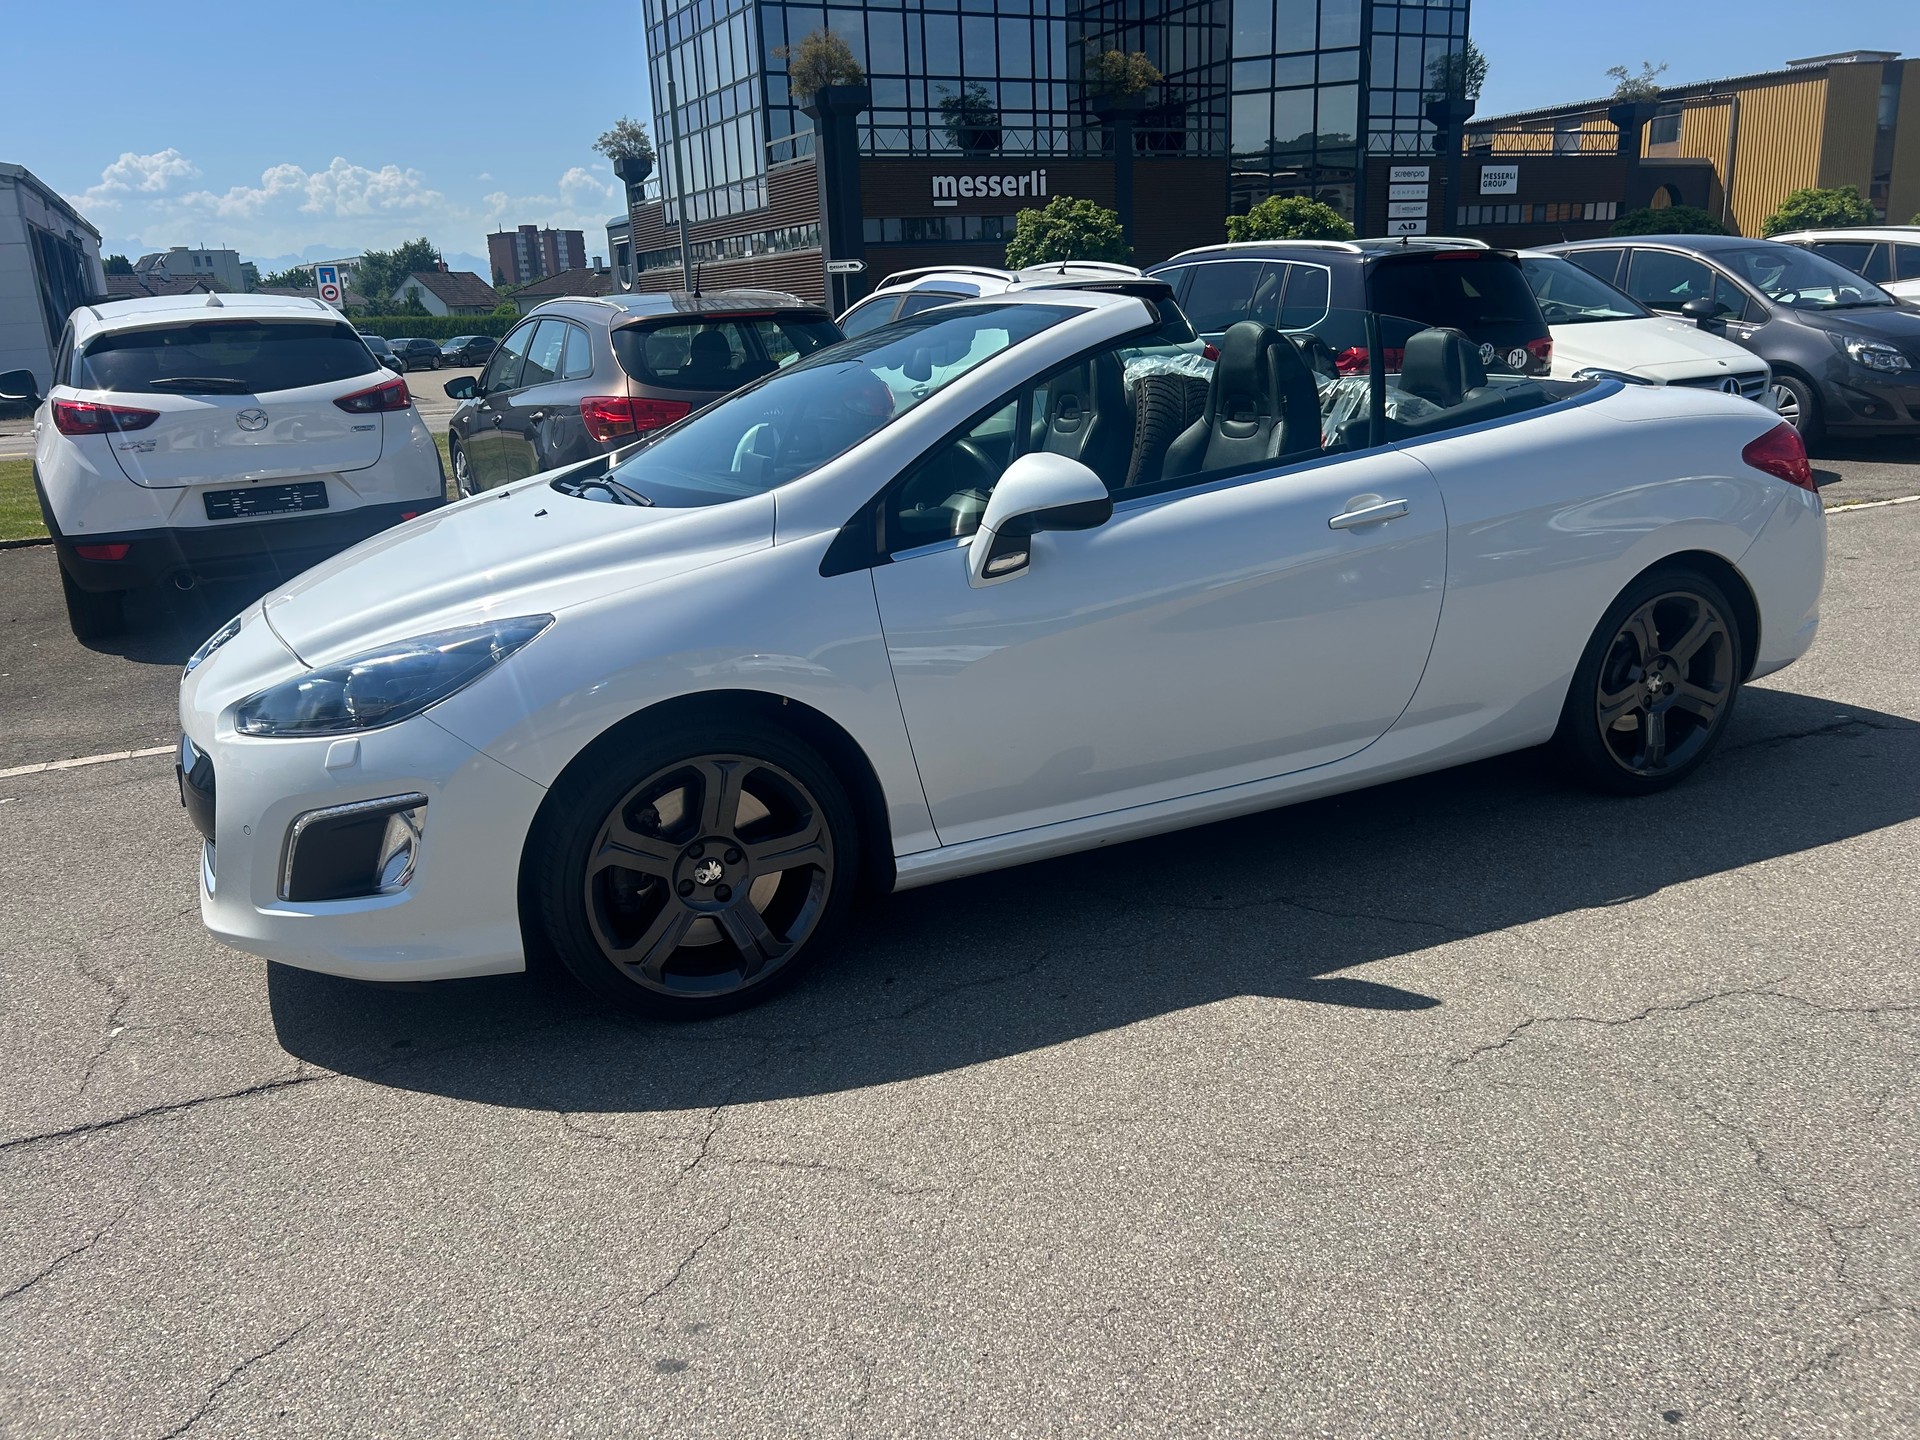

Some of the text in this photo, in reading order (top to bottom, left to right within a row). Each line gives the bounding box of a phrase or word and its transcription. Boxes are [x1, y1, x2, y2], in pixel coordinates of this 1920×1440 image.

[1394, 171, 1425, 179] screenpro
[1483, 172, 1516, 180] MESSERLI
[932, 168, 1047, 198] messerli
[1482, 180, 1507, 188] GROUP
[1398, 223, 1417, 231] AD
[1510, 350, 1524, 366] CH
